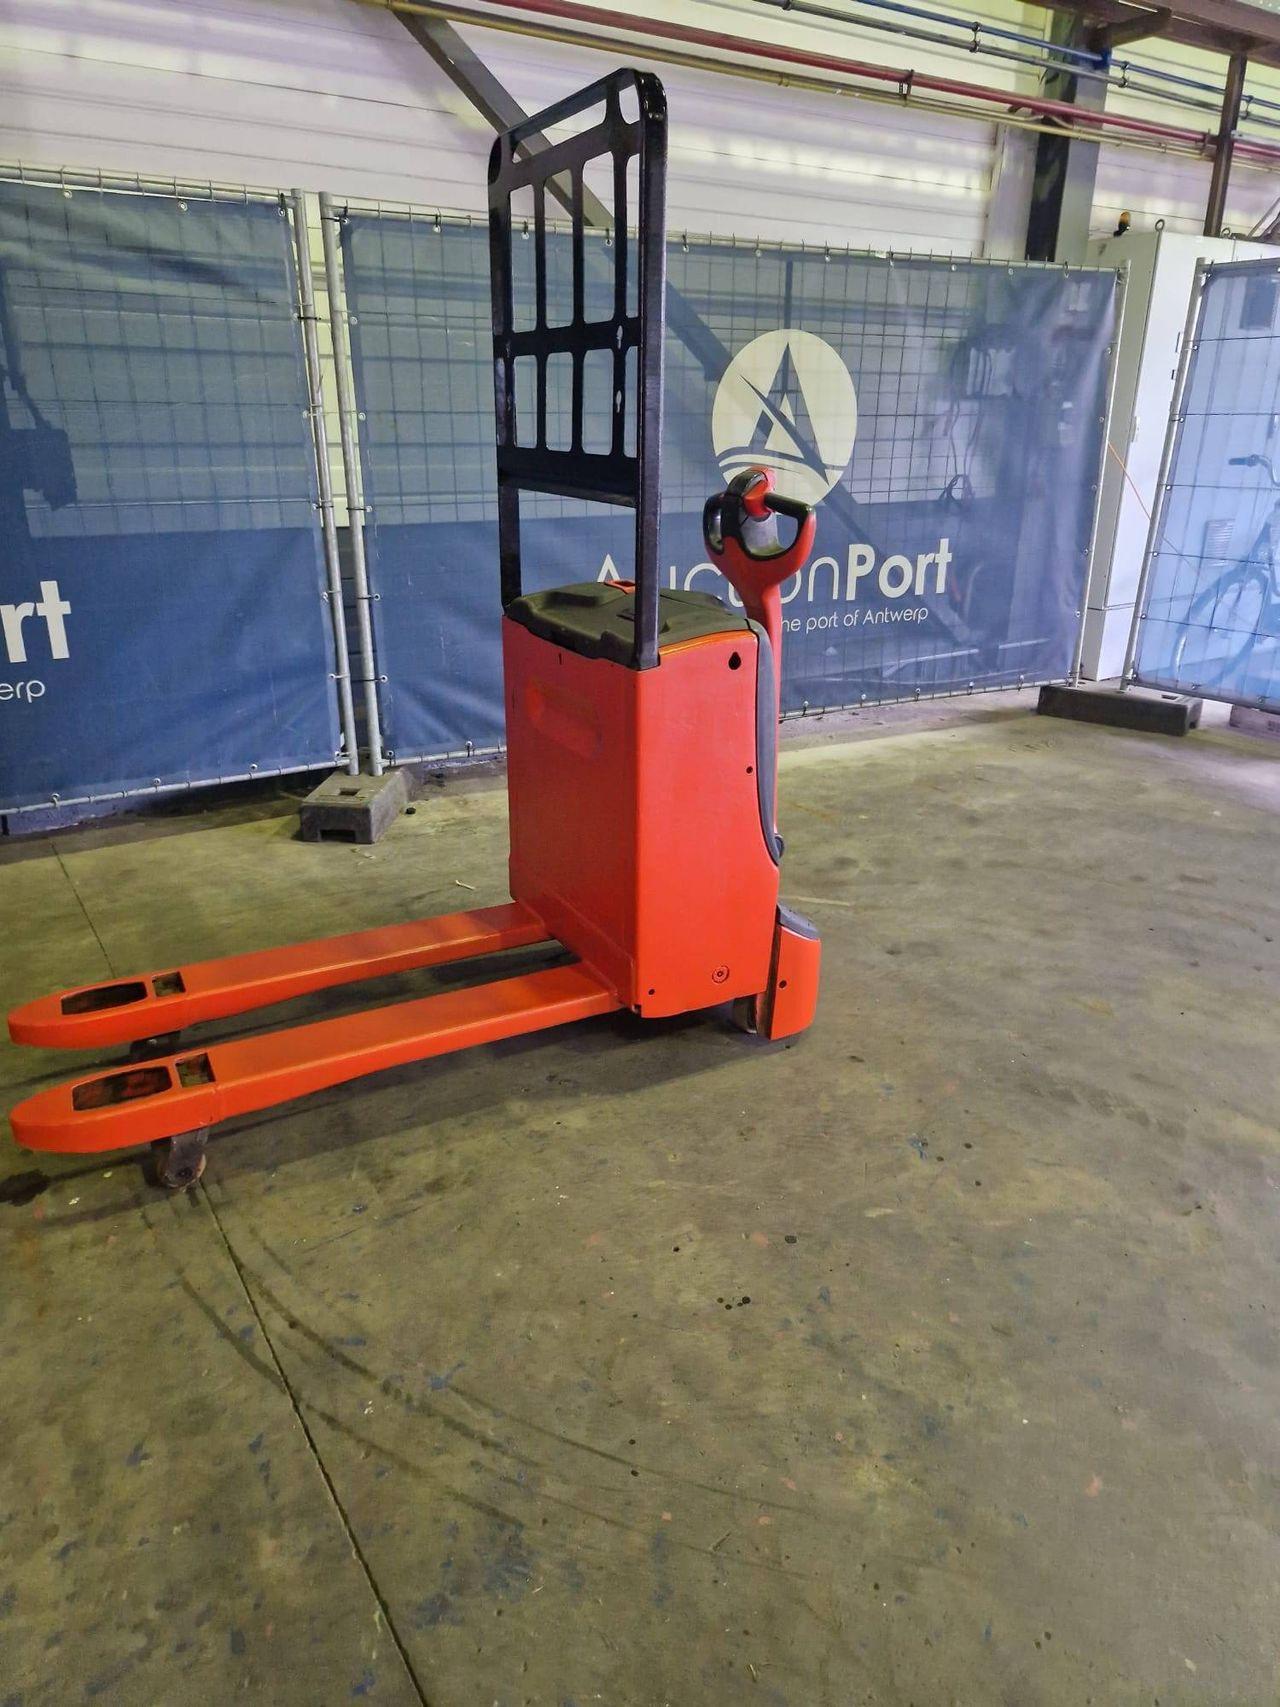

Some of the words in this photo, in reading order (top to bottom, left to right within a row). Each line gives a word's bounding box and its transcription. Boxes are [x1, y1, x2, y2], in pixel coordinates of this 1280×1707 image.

[781, 617, 801, 632] he
[806, 612, 838, 634] port
[843, 609, 859, 627] of
[863, 607, 929, 625] Antwerp
